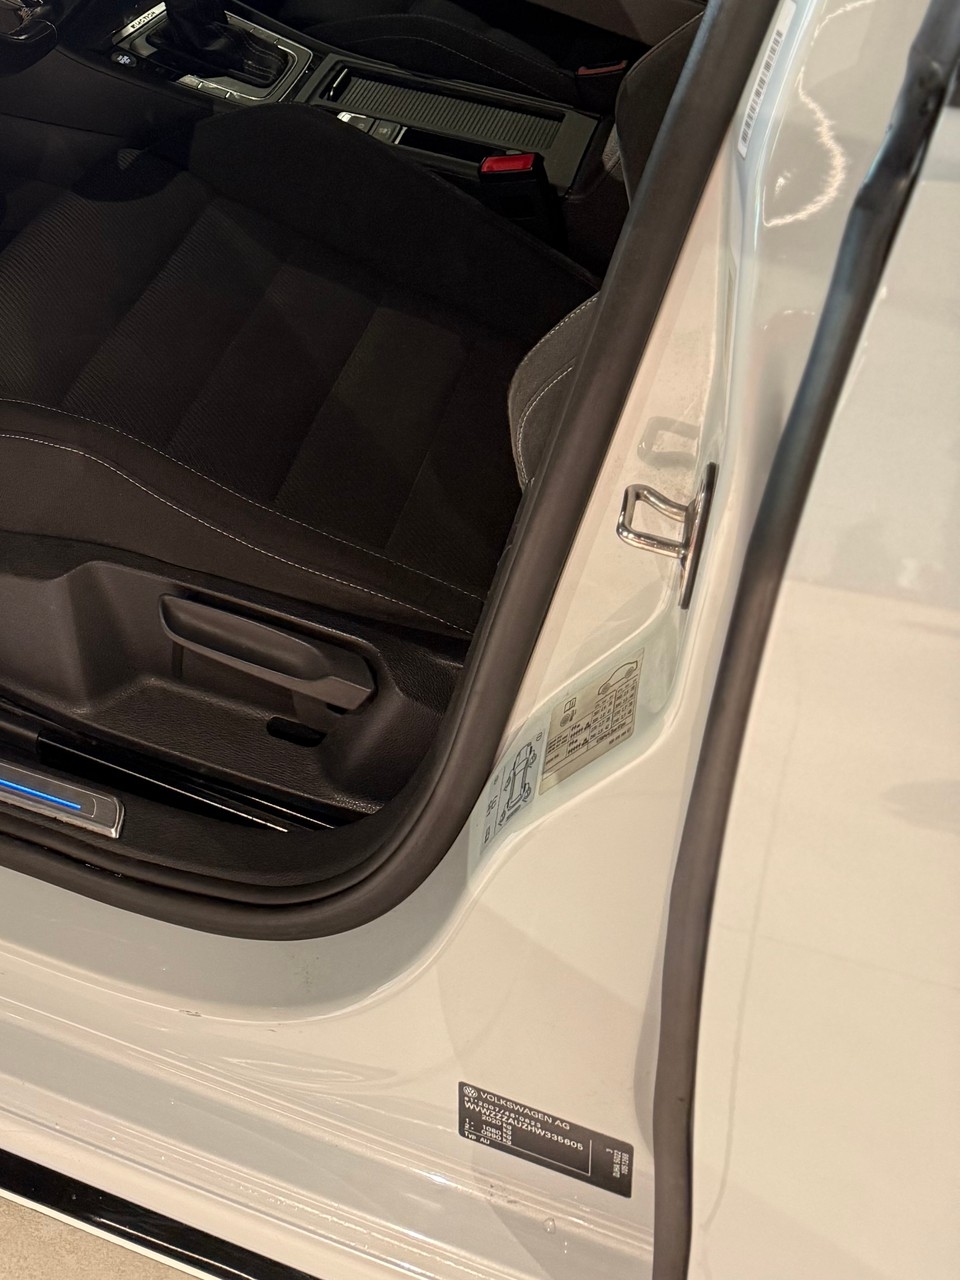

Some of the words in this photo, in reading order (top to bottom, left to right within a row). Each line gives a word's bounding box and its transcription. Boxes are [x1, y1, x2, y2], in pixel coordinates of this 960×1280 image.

[480, 1091, 552, 1123] VOLKSWAGEN
[554, 1119, 570, 1130] AG
[481, 1114, 501, 1126] 2020
[464, 1130, 477, 1140] Typ
